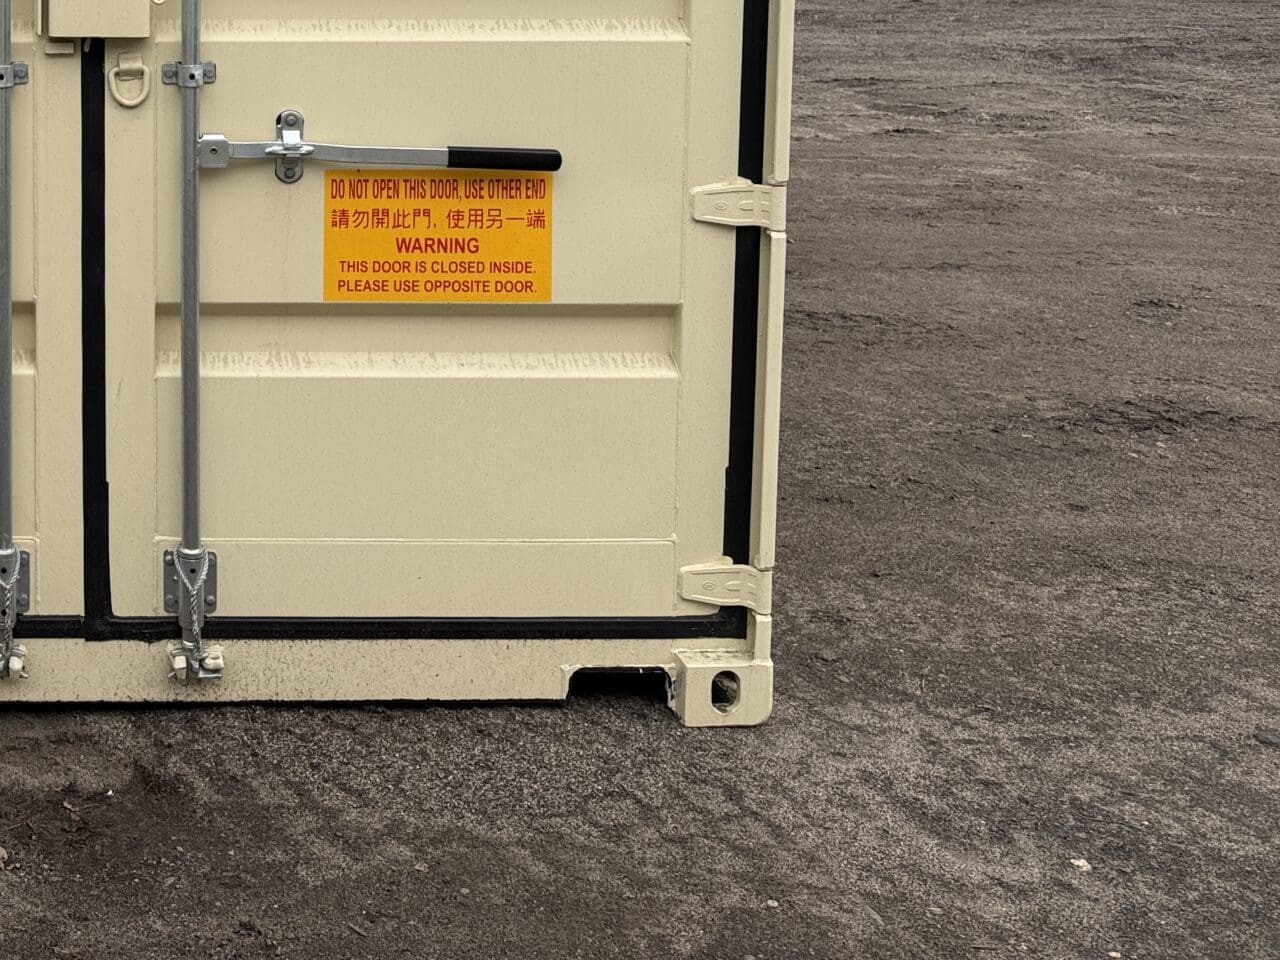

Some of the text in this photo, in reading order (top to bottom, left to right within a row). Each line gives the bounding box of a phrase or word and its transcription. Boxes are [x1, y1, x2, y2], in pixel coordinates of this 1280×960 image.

[330, 178, 546, 201] DO NOT OPEN THIS DOOR, USE OTHER END
[395, 238, 480, 254] WARNING
[339, 260, 537, 274] THIS DOOR IS CLOSED INSIDE.
[337, 280, 537, 293] PLEASE USE OPPOSITE DOOR.
